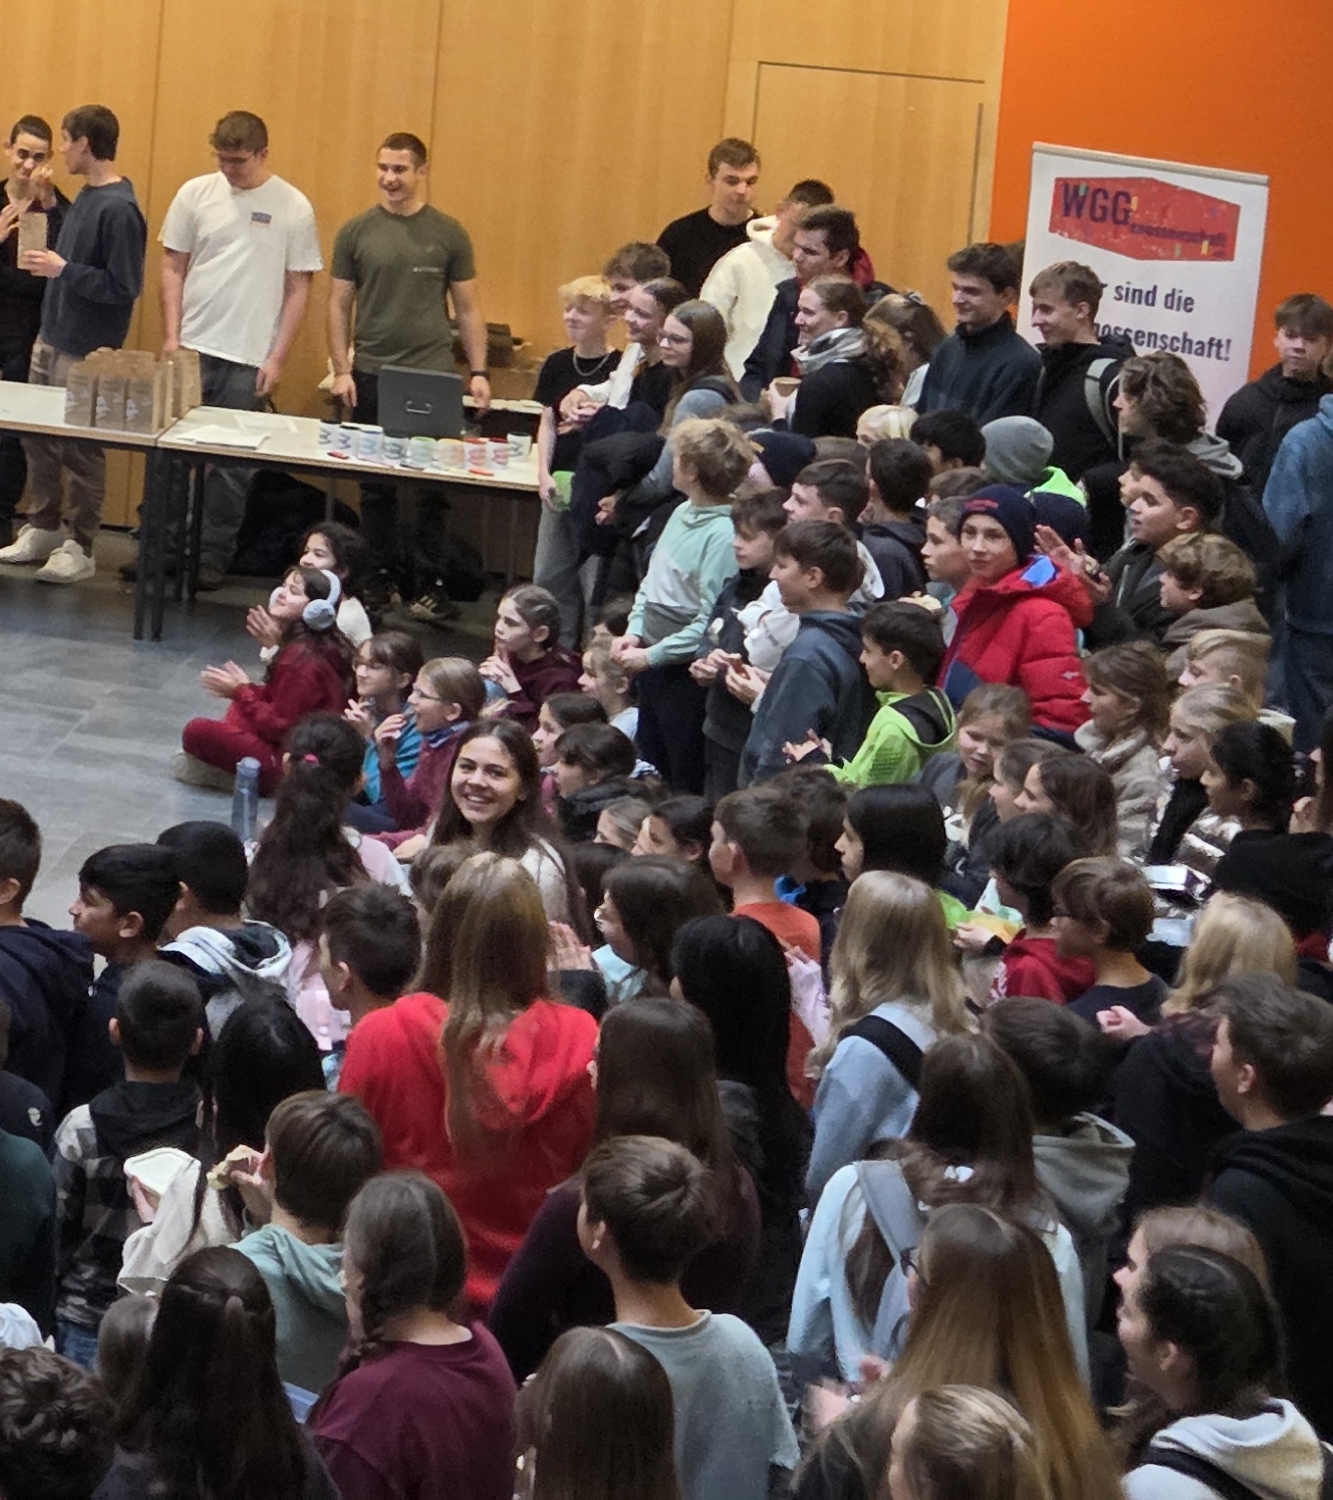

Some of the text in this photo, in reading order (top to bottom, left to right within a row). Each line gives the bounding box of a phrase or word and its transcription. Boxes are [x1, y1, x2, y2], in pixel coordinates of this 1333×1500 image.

[1113, 281, 1195, 313] sind die
[1093, 322, 1232, 361] nossenschaft!
